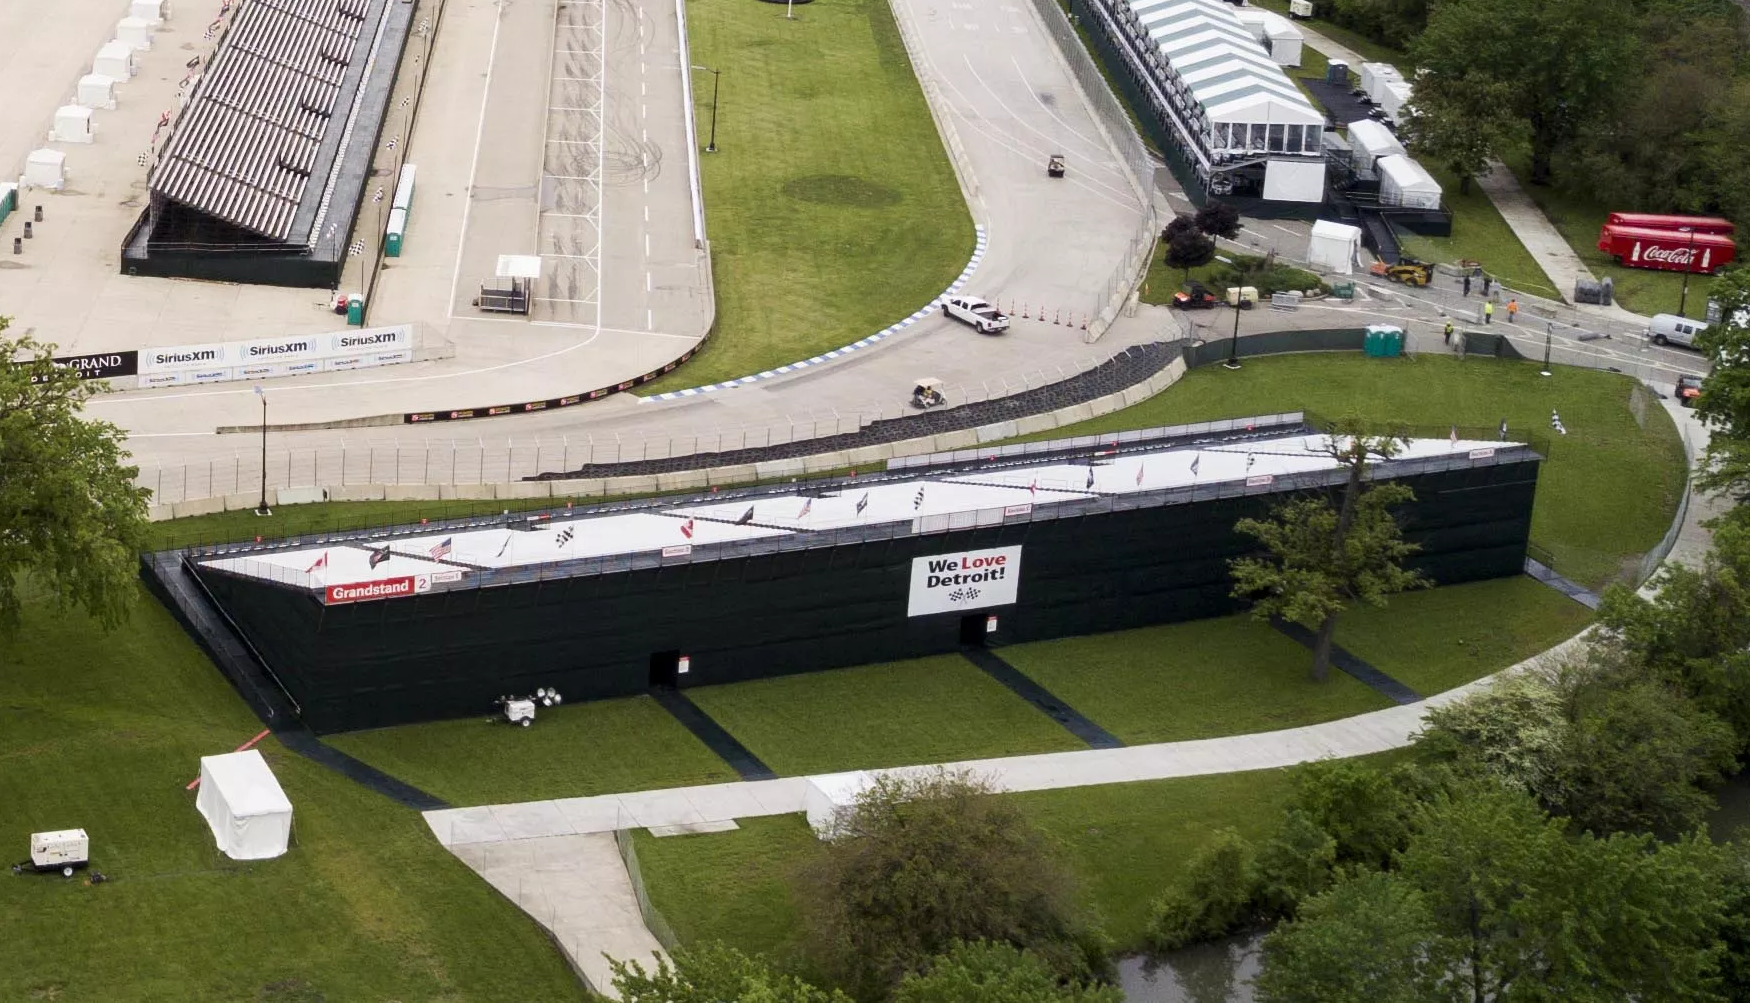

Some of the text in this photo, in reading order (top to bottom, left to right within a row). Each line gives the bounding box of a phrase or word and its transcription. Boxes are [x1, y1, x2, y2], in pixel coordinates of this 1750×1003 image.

[69, 355, 123, 369] GRAND
[928, 555, 1007, 574] We Love
[927, 567, 1005, 588] Detroit!
[333, 578, 427, 599] Grandstand 2
